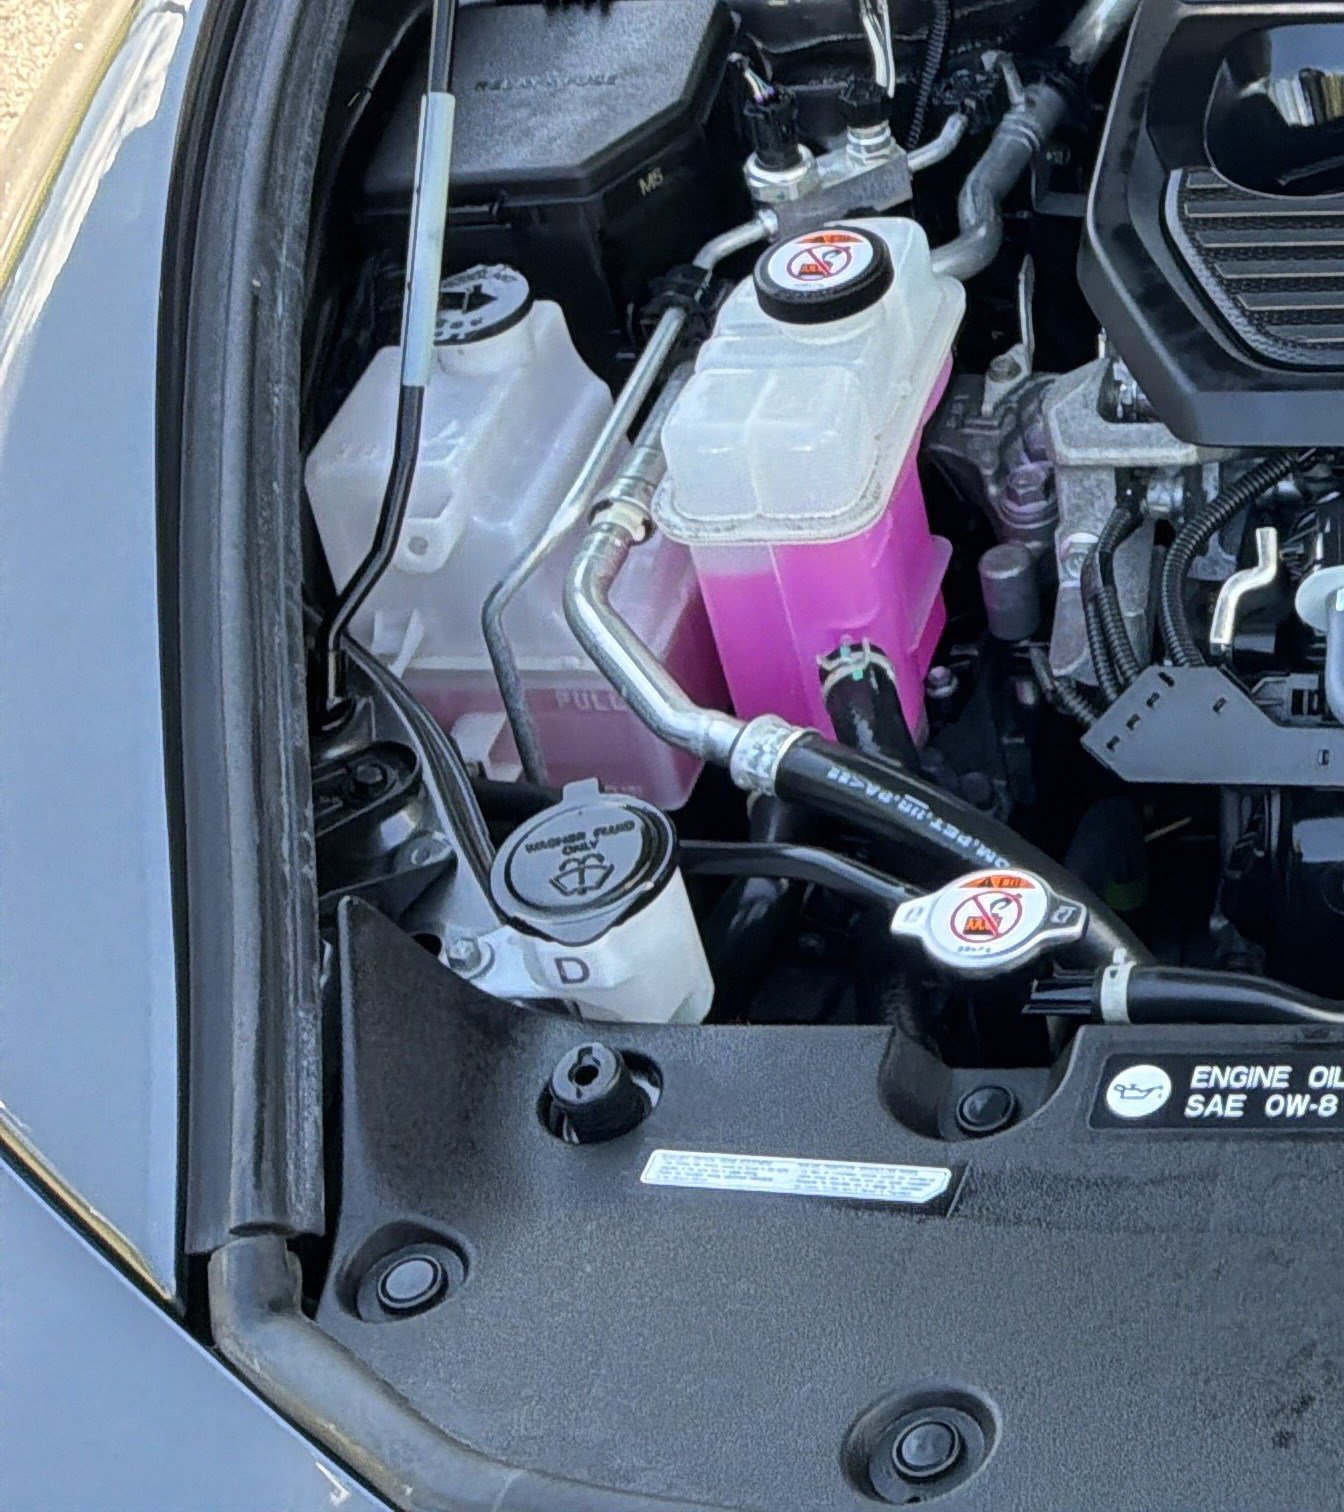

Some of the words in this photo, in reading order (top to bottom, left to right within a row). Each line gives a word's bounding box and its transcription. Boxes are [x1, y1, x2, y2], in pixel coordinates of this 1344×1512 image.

[554, 956, 590, 984] D
[1190, 1065, 1293, 1089] ENGINE
[1183, 1093, 1247, 1118] SAE
[1265, 1093, 1339, 1118] 0W-8
